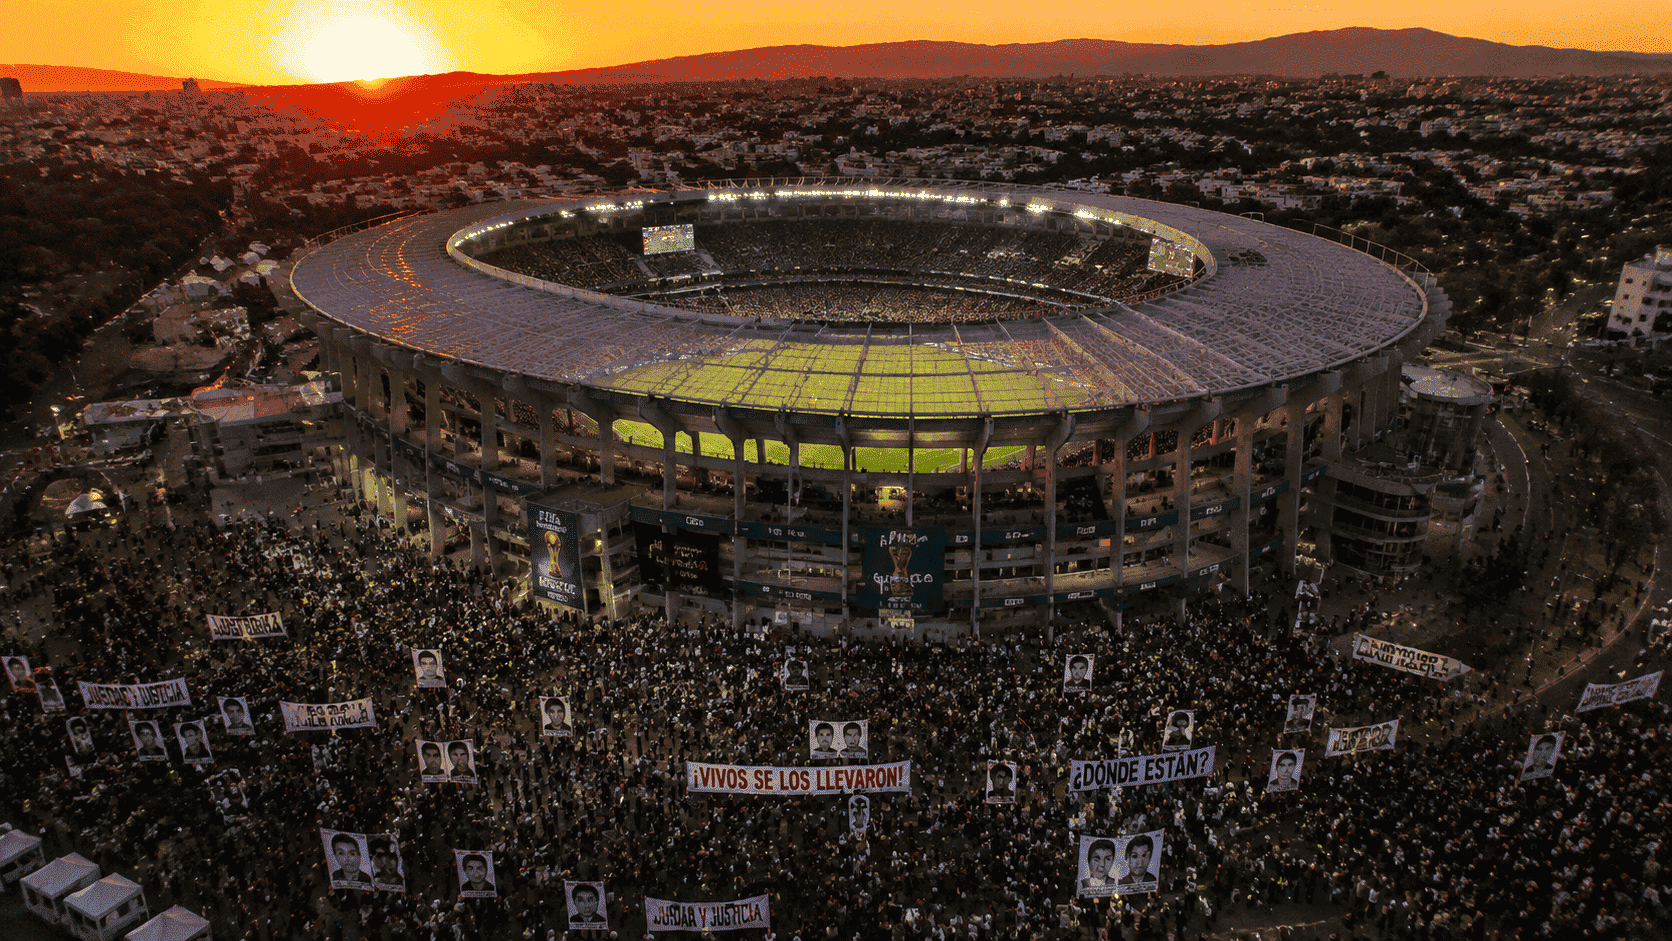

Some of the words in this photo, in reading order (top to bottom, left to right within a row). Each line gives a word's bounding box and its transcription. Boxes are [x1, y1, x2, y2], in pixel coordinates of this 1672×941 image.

[694, 767, 748, 790] ¡VIVOS
[754, 770, 773, 790] SE
[780, 770, 810, 790] LOS
[816, 766, 903, 790] LLEVARON!
[699, 906, 706, 928] Y
